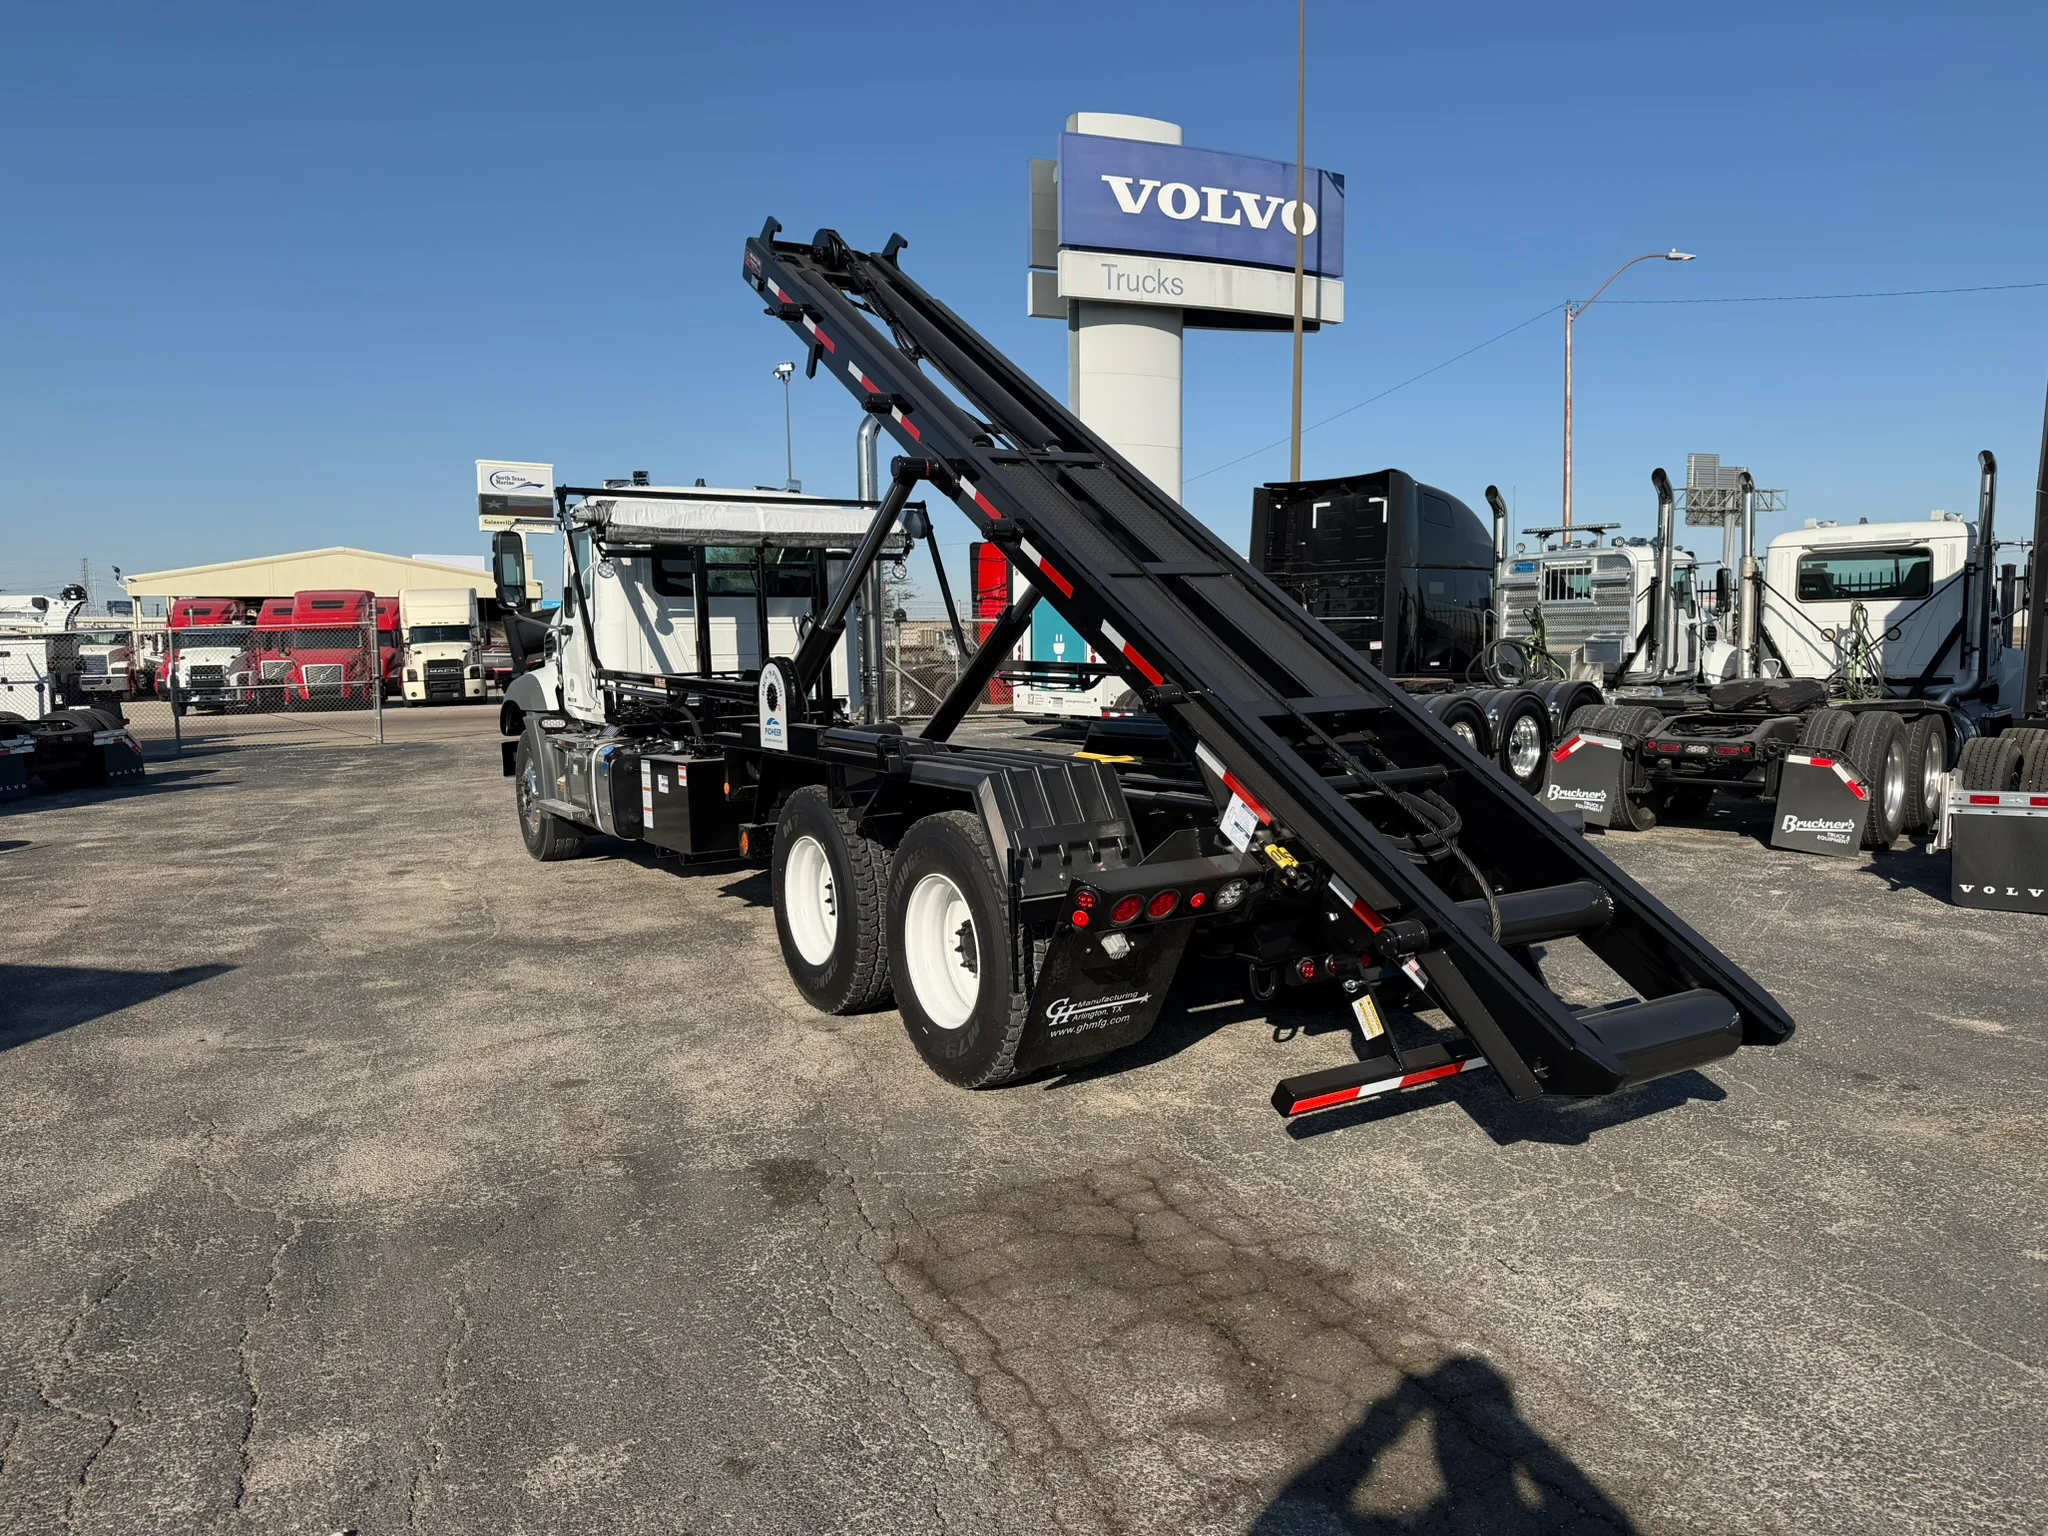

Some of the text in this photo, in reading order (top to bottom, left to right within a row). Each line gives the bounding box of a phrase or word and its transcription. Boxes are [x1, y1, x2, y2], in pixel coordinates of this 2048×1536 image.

[1101, 174, 1317, 236] VOLVO
[1101, 263, 1184, 296] Trucks
[109, 767, 144, 777] VOLVO
[1547, 784, 1607, 801] Bruckner's
[1575, 803, 1603, 813] EQUIPMENT
[1583, 801, 1600, 809] TRUCK
[1781, 814, 1855, 834] Bruckner's
[1816, 834, 1850, 845] EQUIPMENT
[1827, 832, 1846, 840] TRUCK
[1077, 991, 1139, 1008] Manufacturing
[1072, 1004, 1124, 1022] Arlington, TX
[1050, 1014, 1131, 1038] www.ghmfg.com
